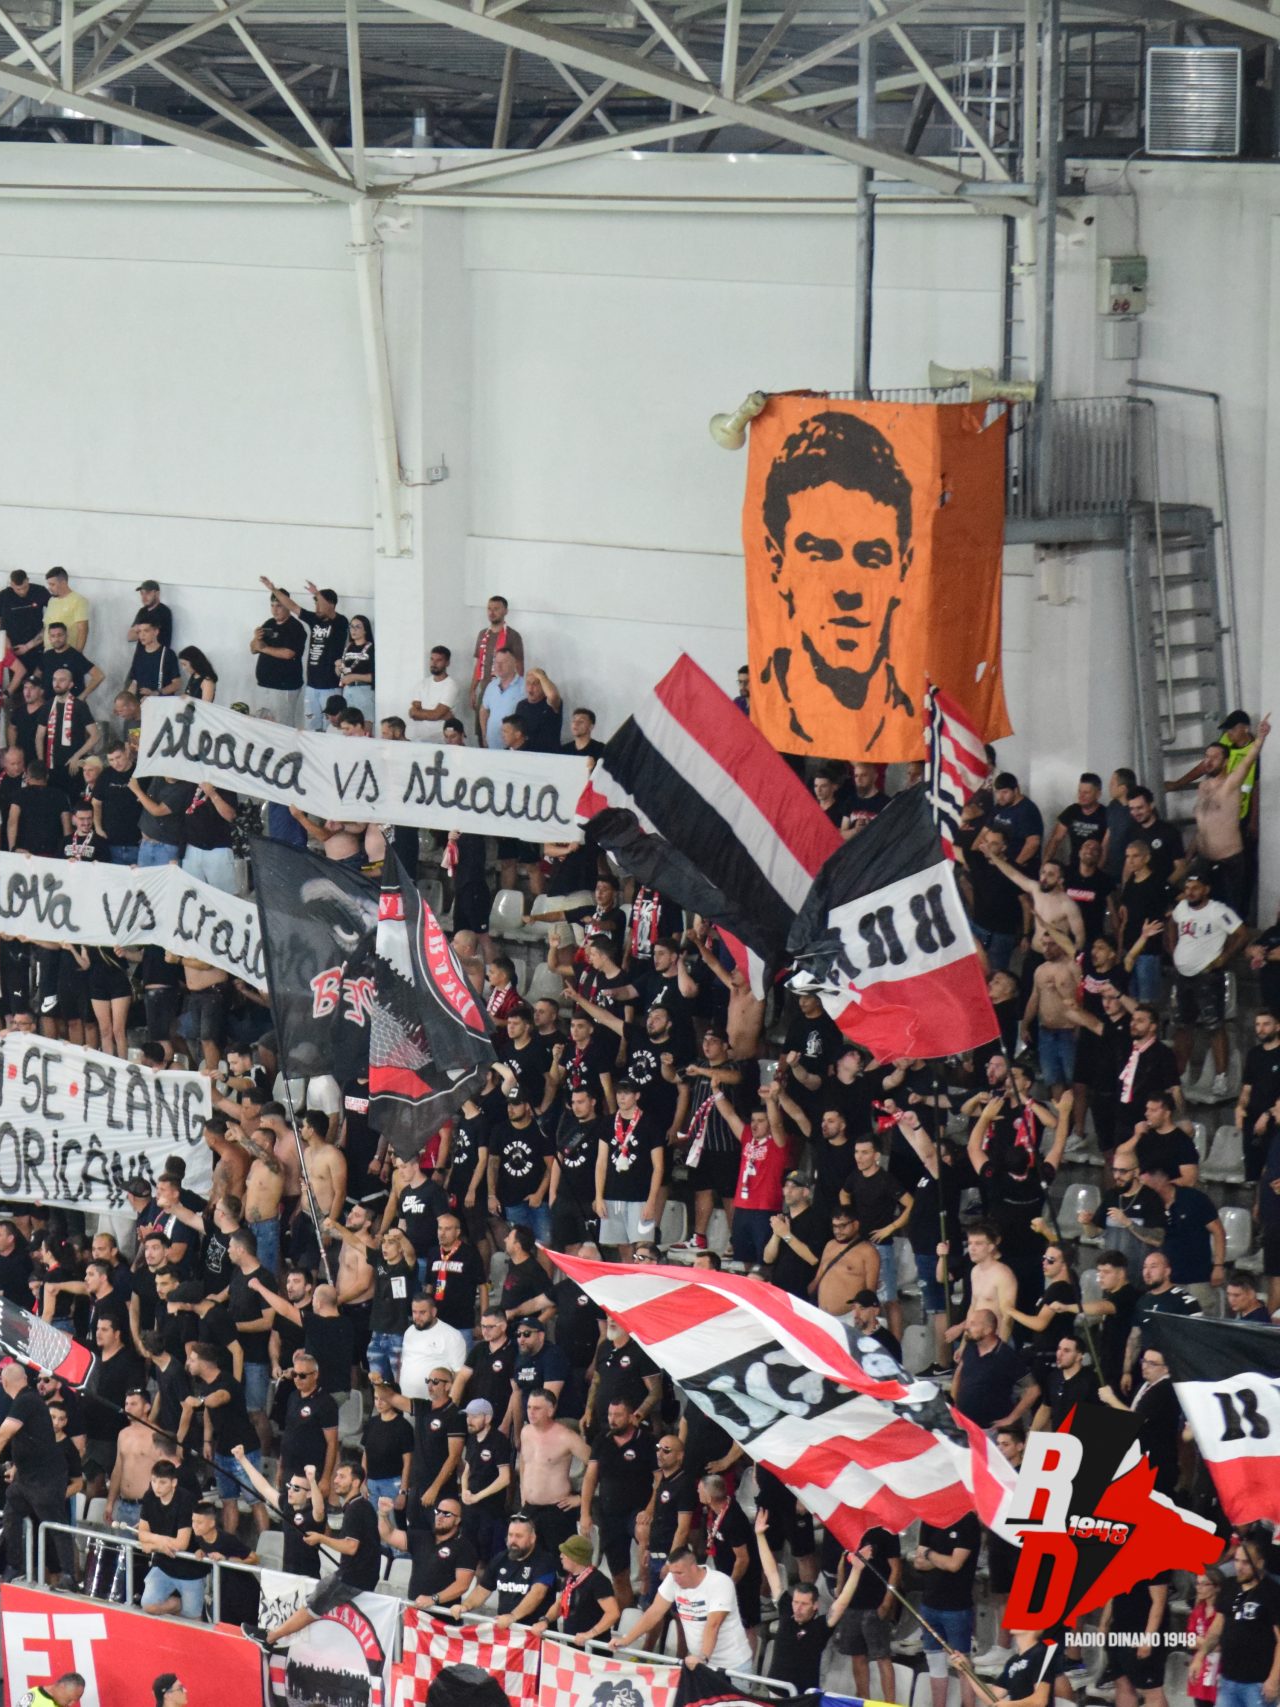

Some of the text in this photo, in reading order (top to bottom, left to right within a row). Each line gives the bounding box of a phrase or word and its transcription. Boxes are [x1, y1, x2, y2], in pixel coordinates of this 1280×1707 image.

[145, 700, 572, 825] steaua vs steaua
[102, 886, 156, 935] vs
[20, 1046, 64, 1121] SE
[83, 1059, 206, 1146] PLÂNG
[503, 1140, 532, 1155] ULTRAS
